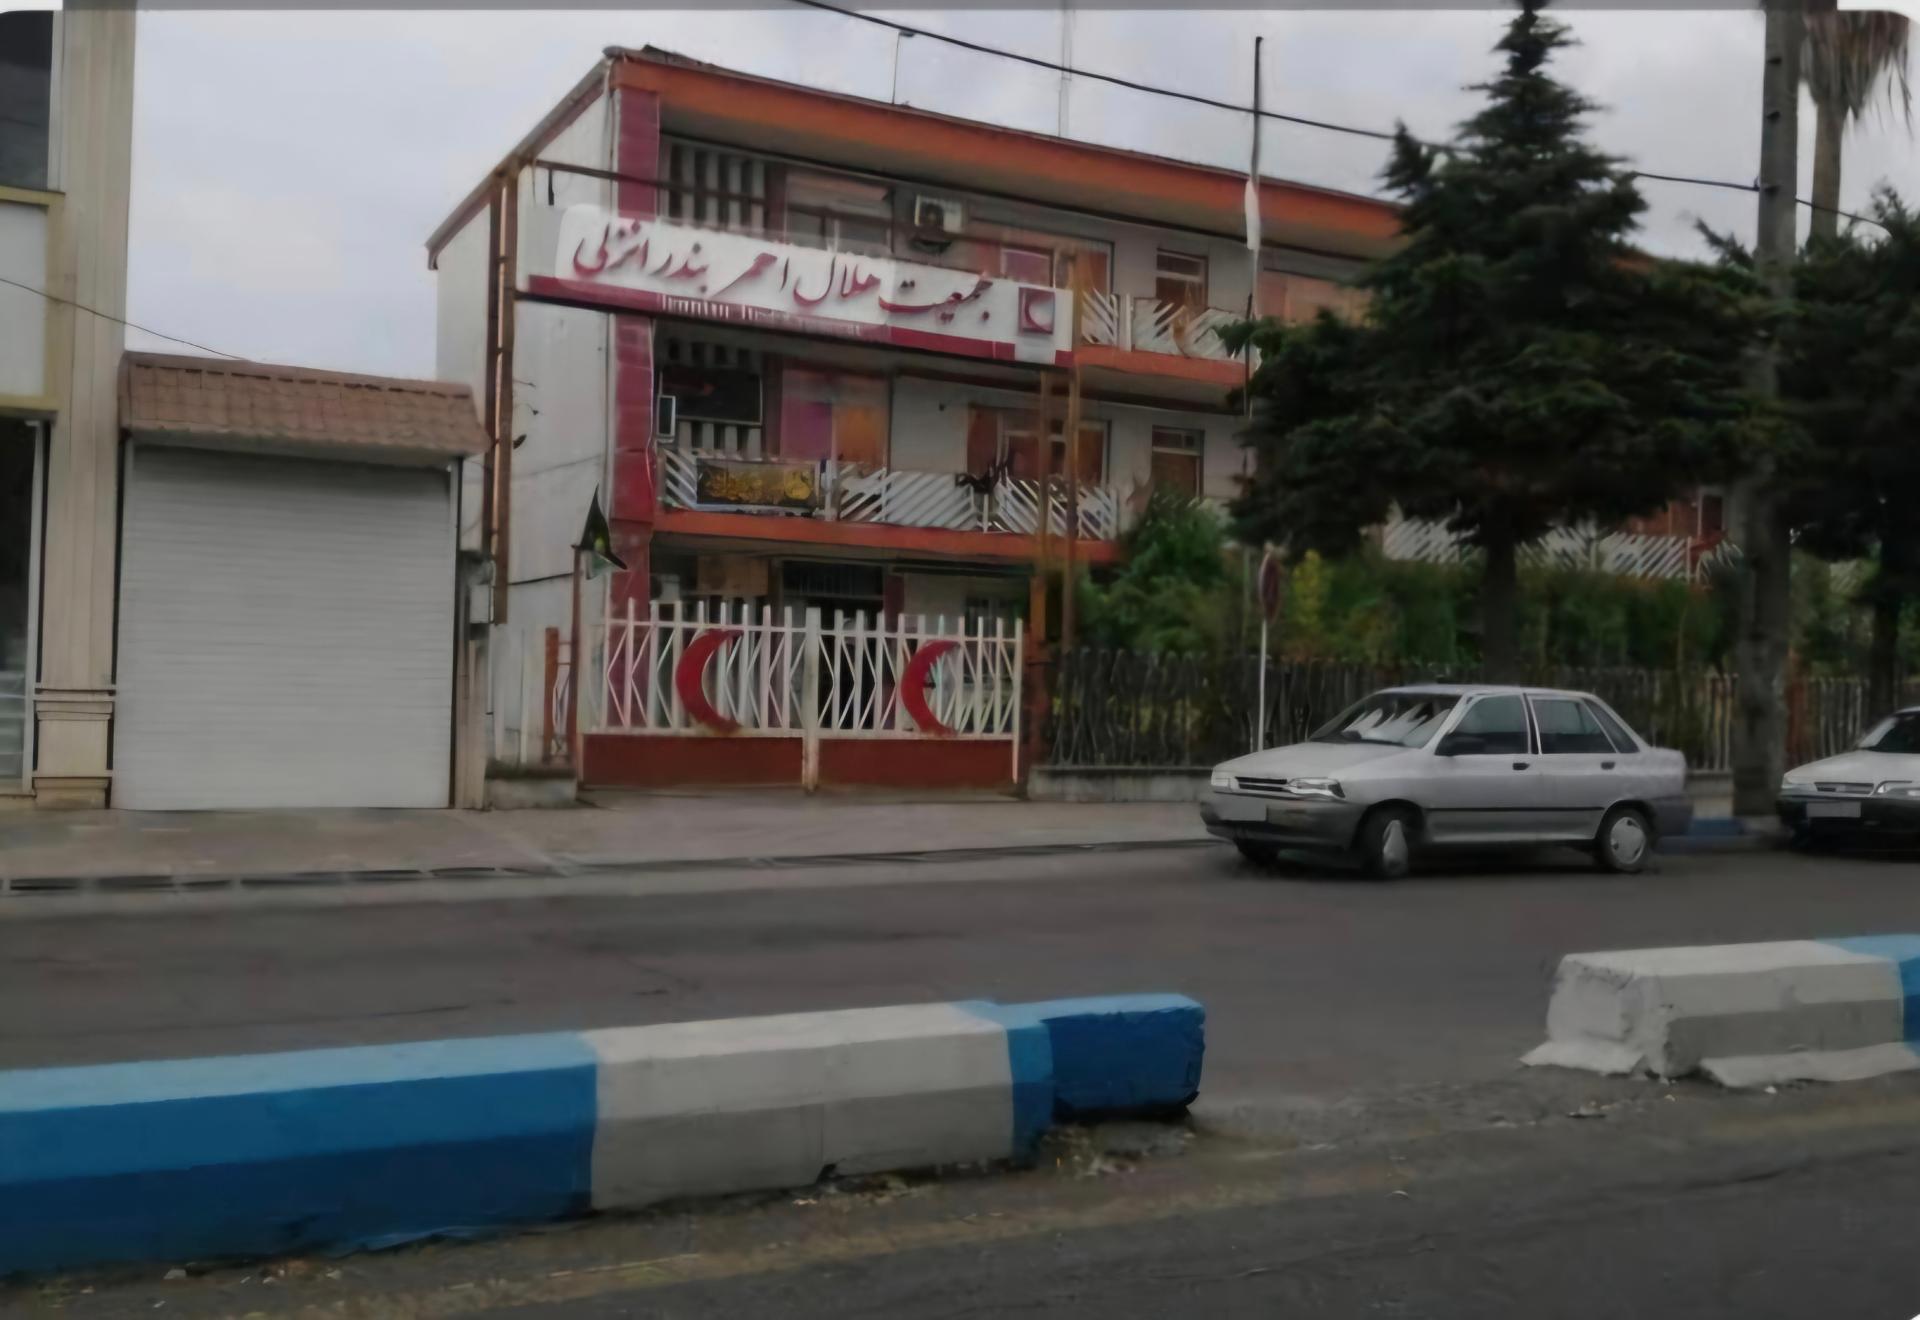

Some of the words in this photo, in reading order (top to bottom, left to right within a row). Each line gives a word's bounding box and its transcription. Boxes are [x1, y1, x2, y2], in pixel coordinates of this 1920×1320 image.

[709, 252, 790, 299] احمر
[793, 255, 881, 307] هلال
[878, 278, 993, 323] جمعیت
